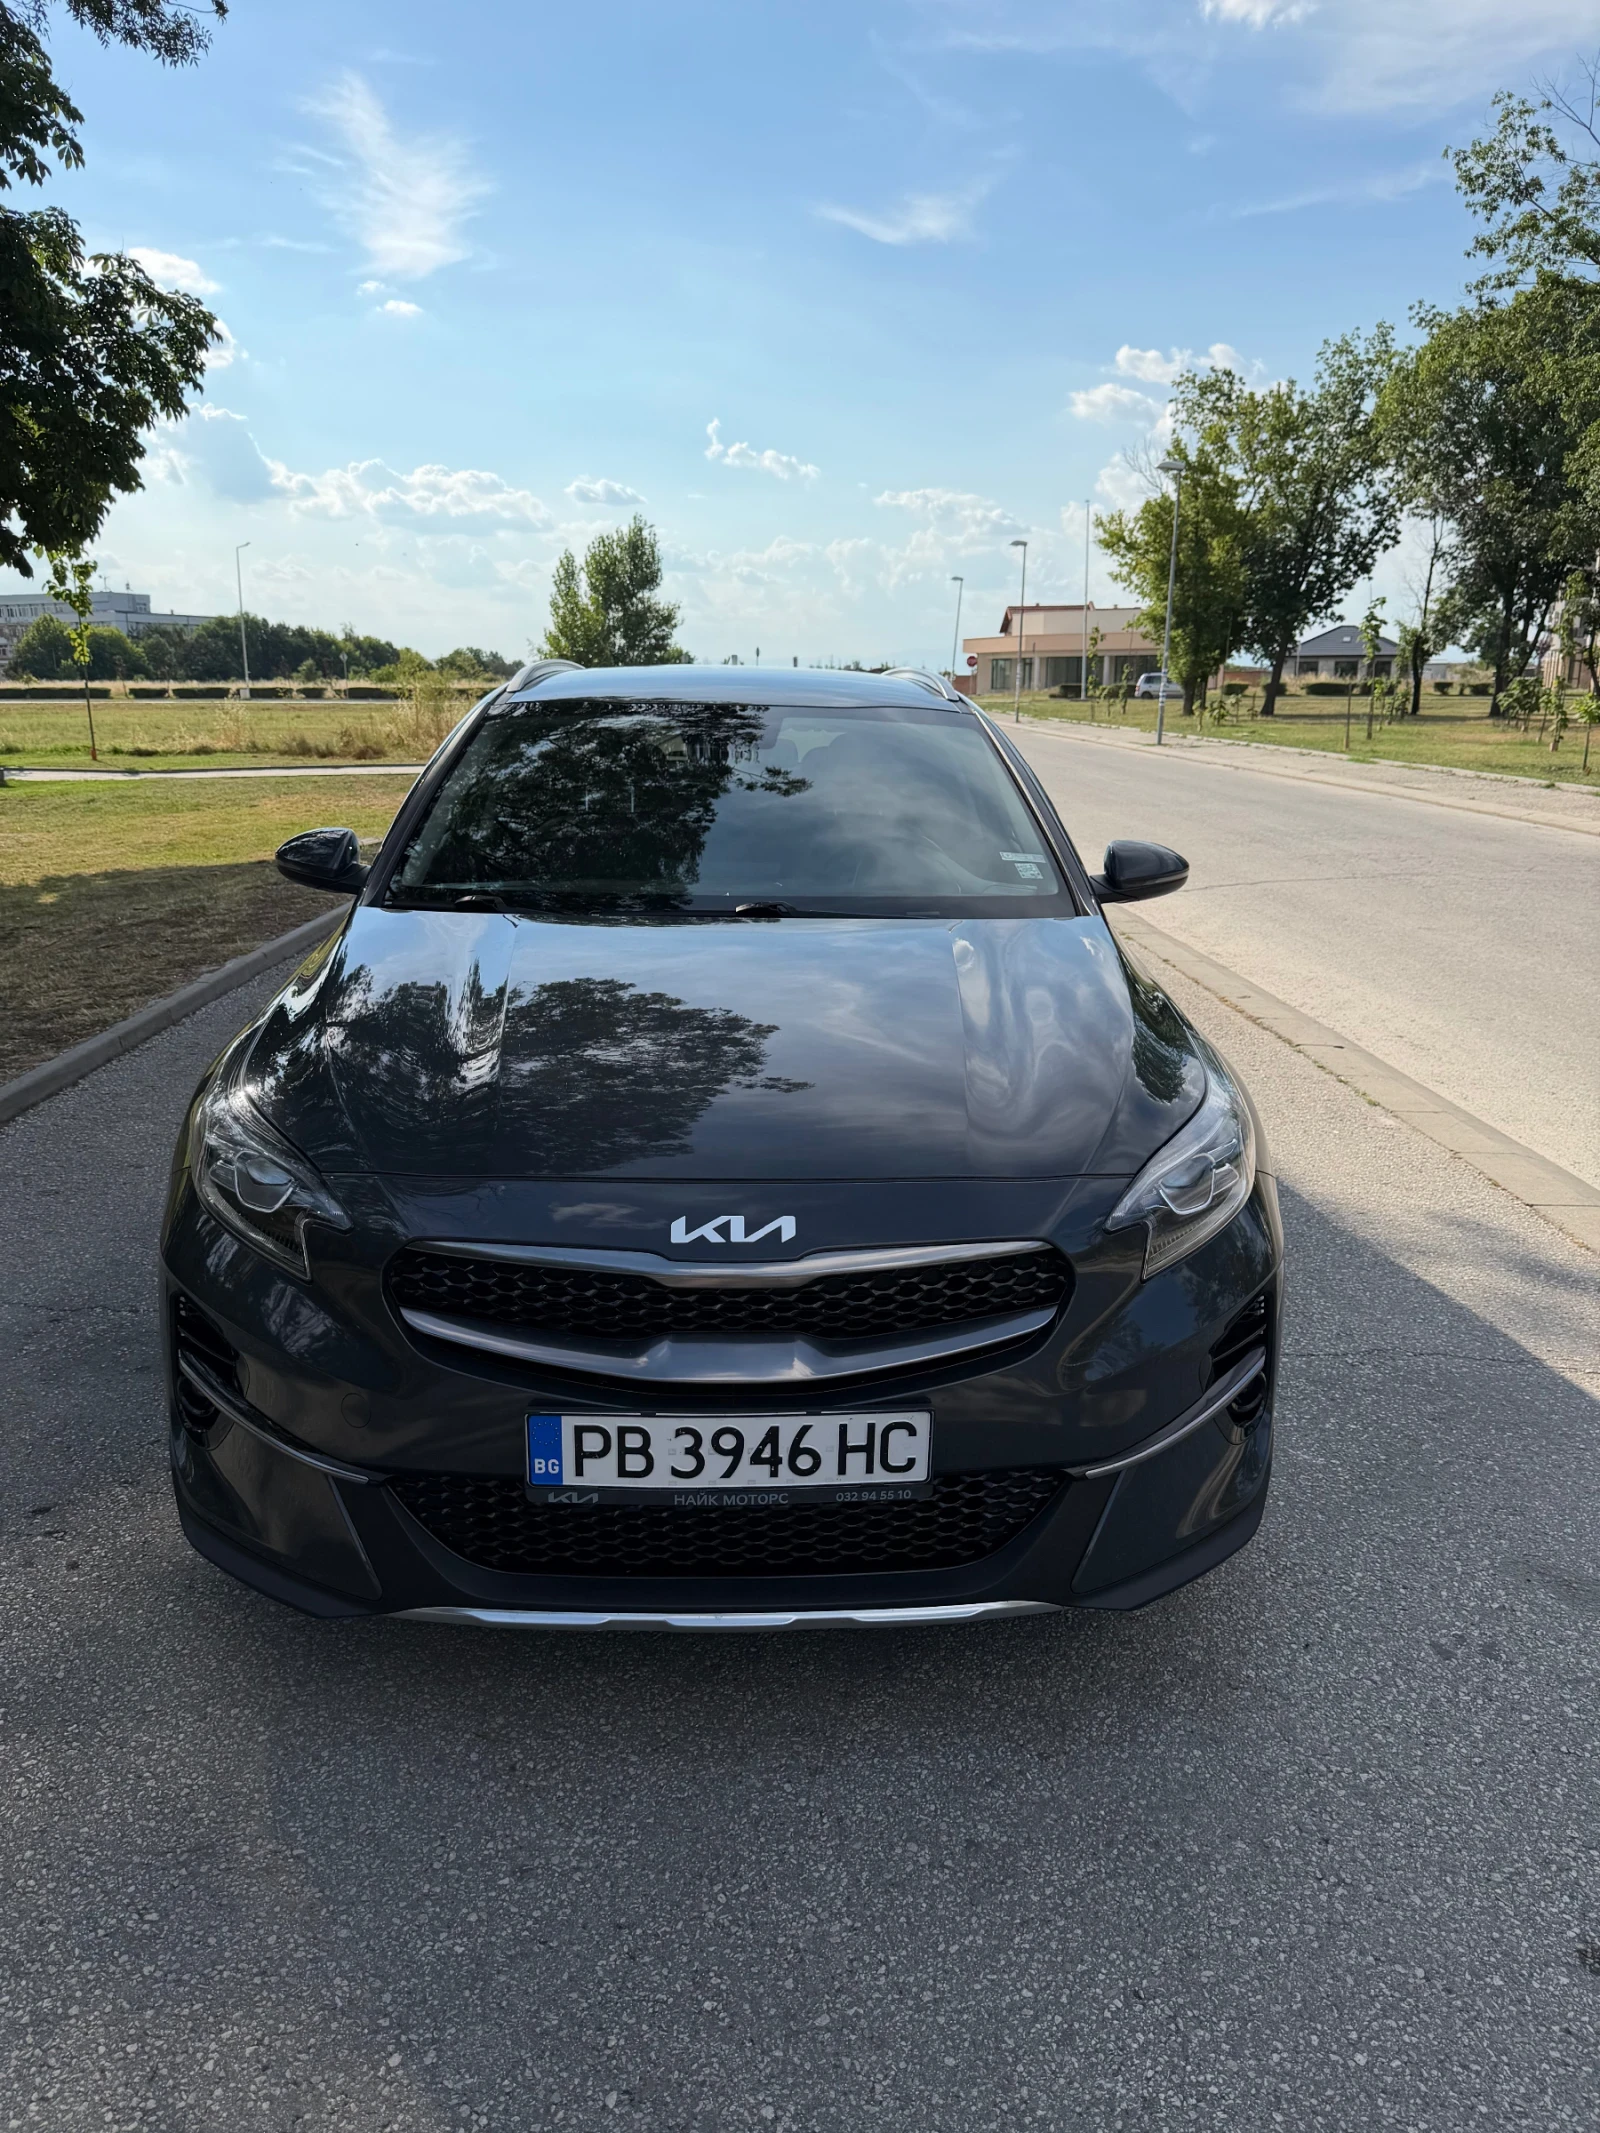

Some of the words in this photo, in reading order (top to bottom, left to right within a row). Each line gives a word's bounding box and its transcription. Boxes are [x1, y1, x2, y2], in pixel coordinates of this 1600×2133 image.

[671, 1216, 796, 1243] KIA
[574, 1425, 654, 1478] PB
[671, 1424, 822, 1479] 3946
[838, 1421, 917, 1475] HC
[534, 1459, 560, 1474] BG
[548, 1492, 599, 1503] KIA
[674, 1491, 718, 1506] НАЙК
[723, 1493, 789, 1506] МОТОРС
[836, 1493, 858, 1502] 032
[861, 1492, 876, 1501] 94
[880, 1491, 894, 1500] 55
[898, 1489, 912, 1500] 10
